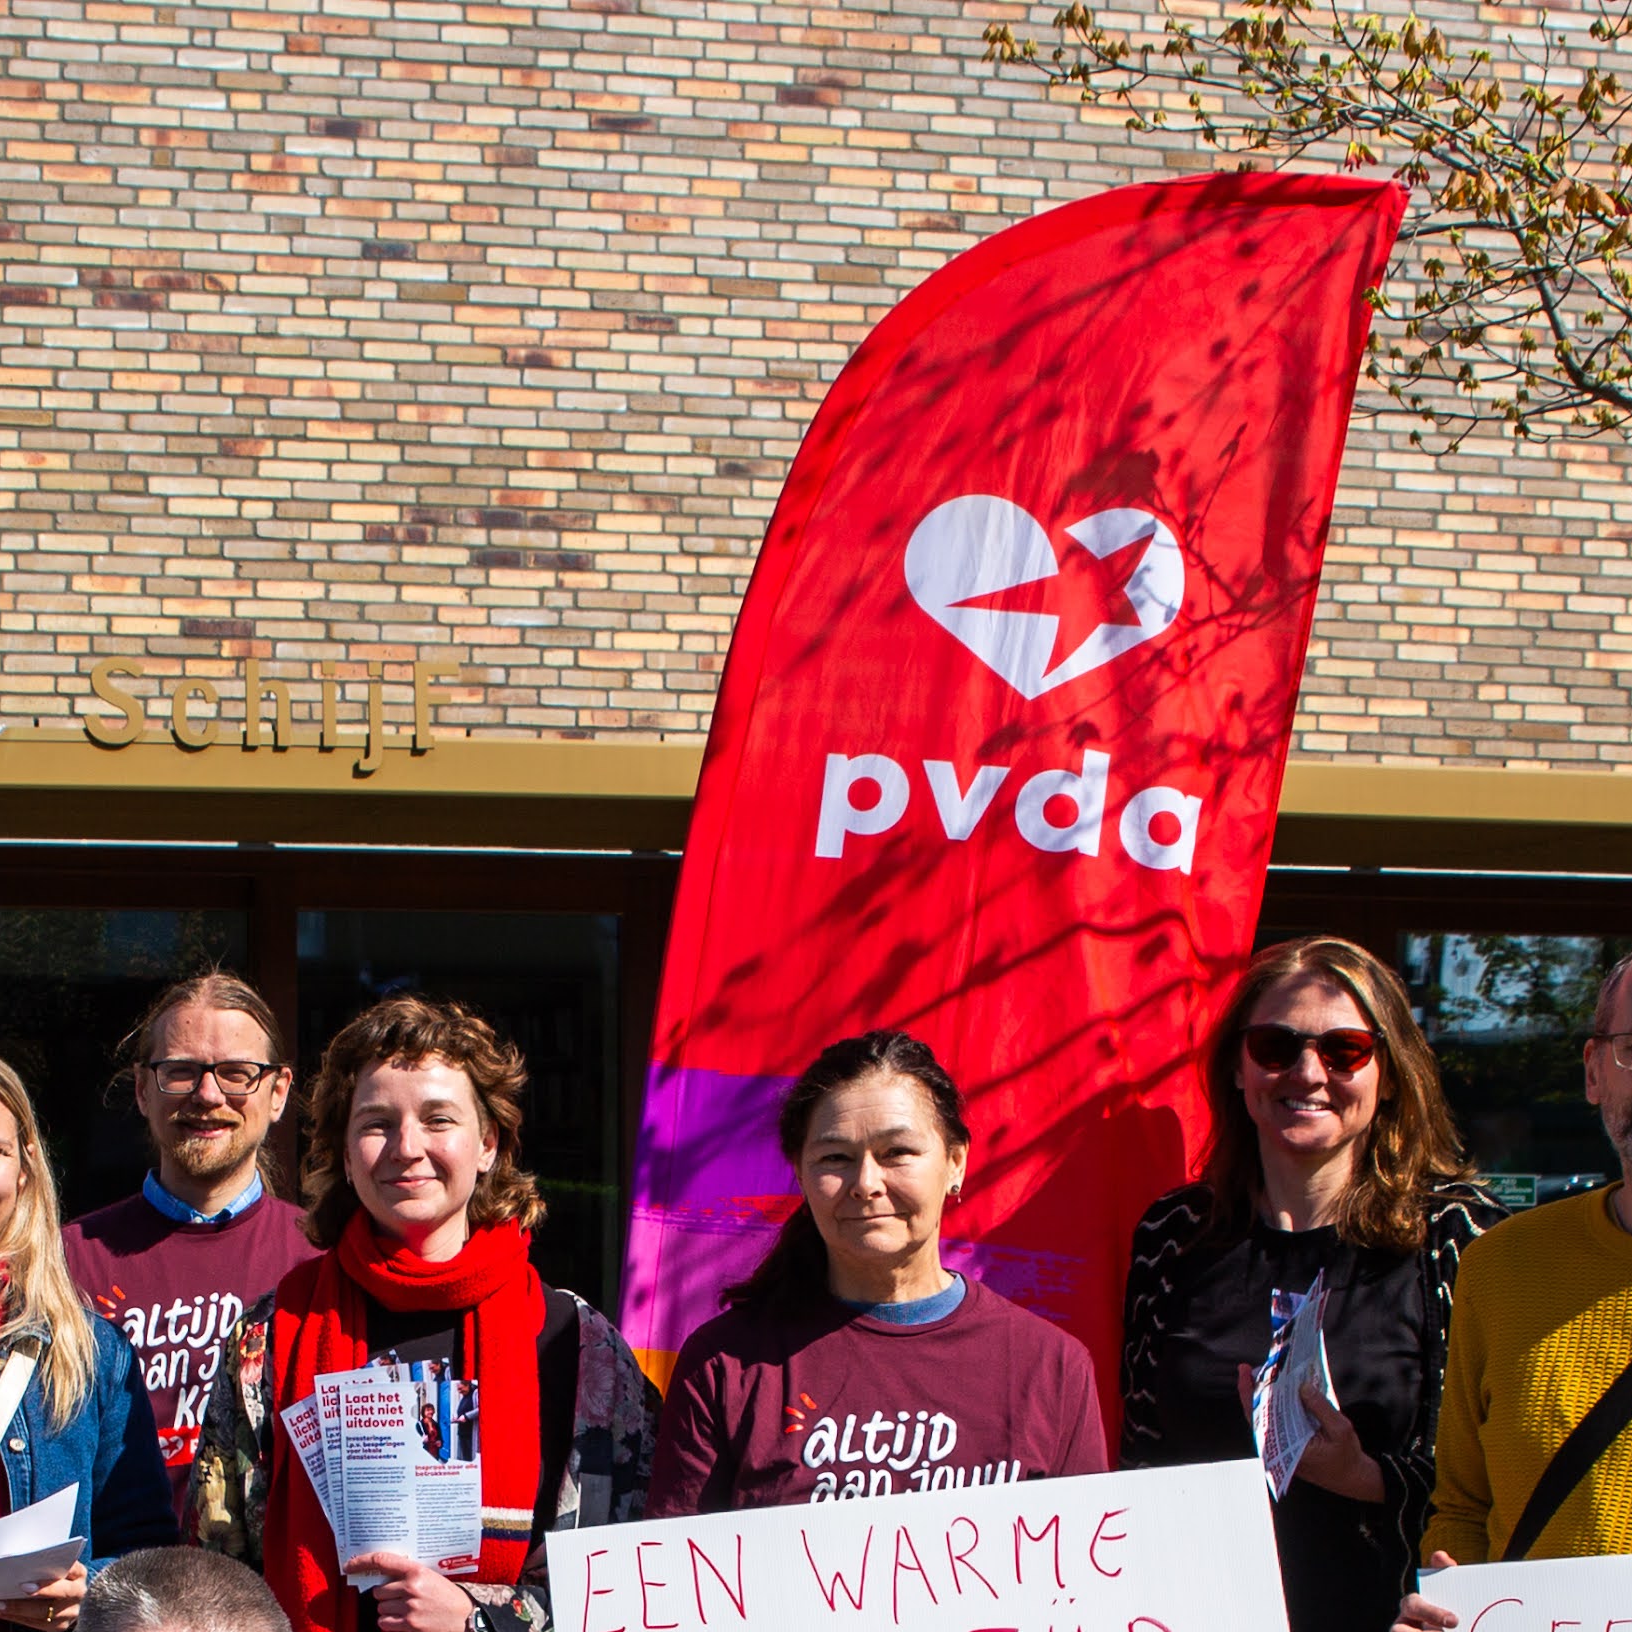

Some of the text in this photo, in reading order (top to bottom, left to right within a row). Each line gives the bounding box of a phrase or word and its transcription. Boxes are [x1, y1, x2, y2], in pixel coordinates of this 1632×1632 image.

[815, 749, 1203, 875] pvda
[346, 1393, 400, 1404] Laat het
[289, 1406, 316, 1427] Laat
[346, 1404, 403, 1416] licht niet
[346, 1417, 404, 1428] uitdoven
[800, 1508, 1129, 1625] WARME
